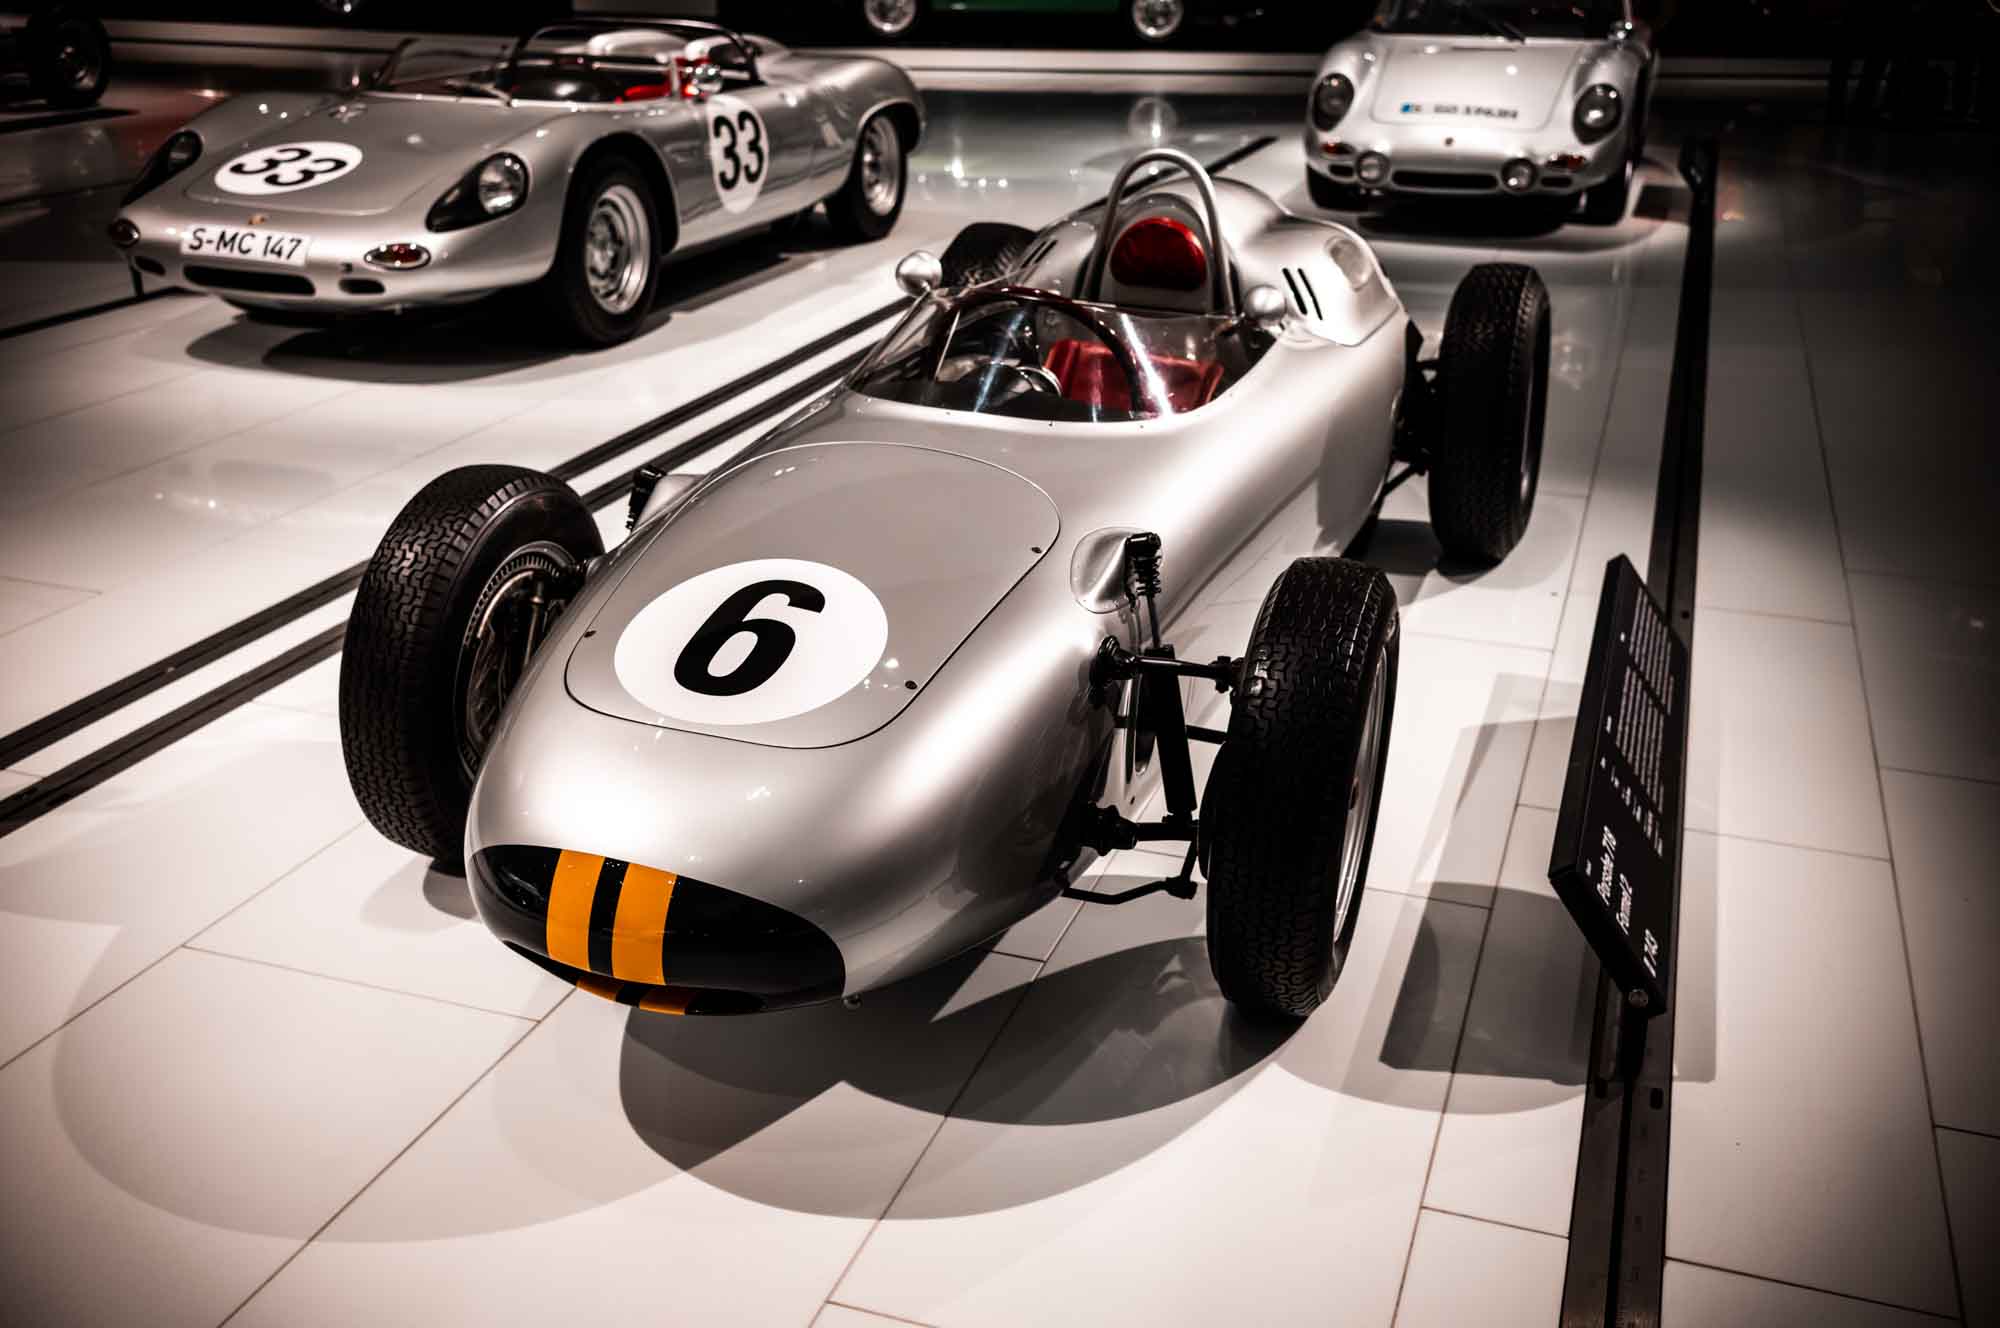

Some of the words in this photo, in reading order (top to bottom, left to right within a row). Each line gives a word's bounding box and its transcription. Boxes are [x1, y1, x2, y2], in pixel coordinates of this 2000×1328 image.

[229, 147, 348, 187] 33
[713, 109, 764, 190] 33
[188, 227, 256, 255] S-MC
[262, 234, 303, 261] 147
[673, 579, 826, 697] 6
